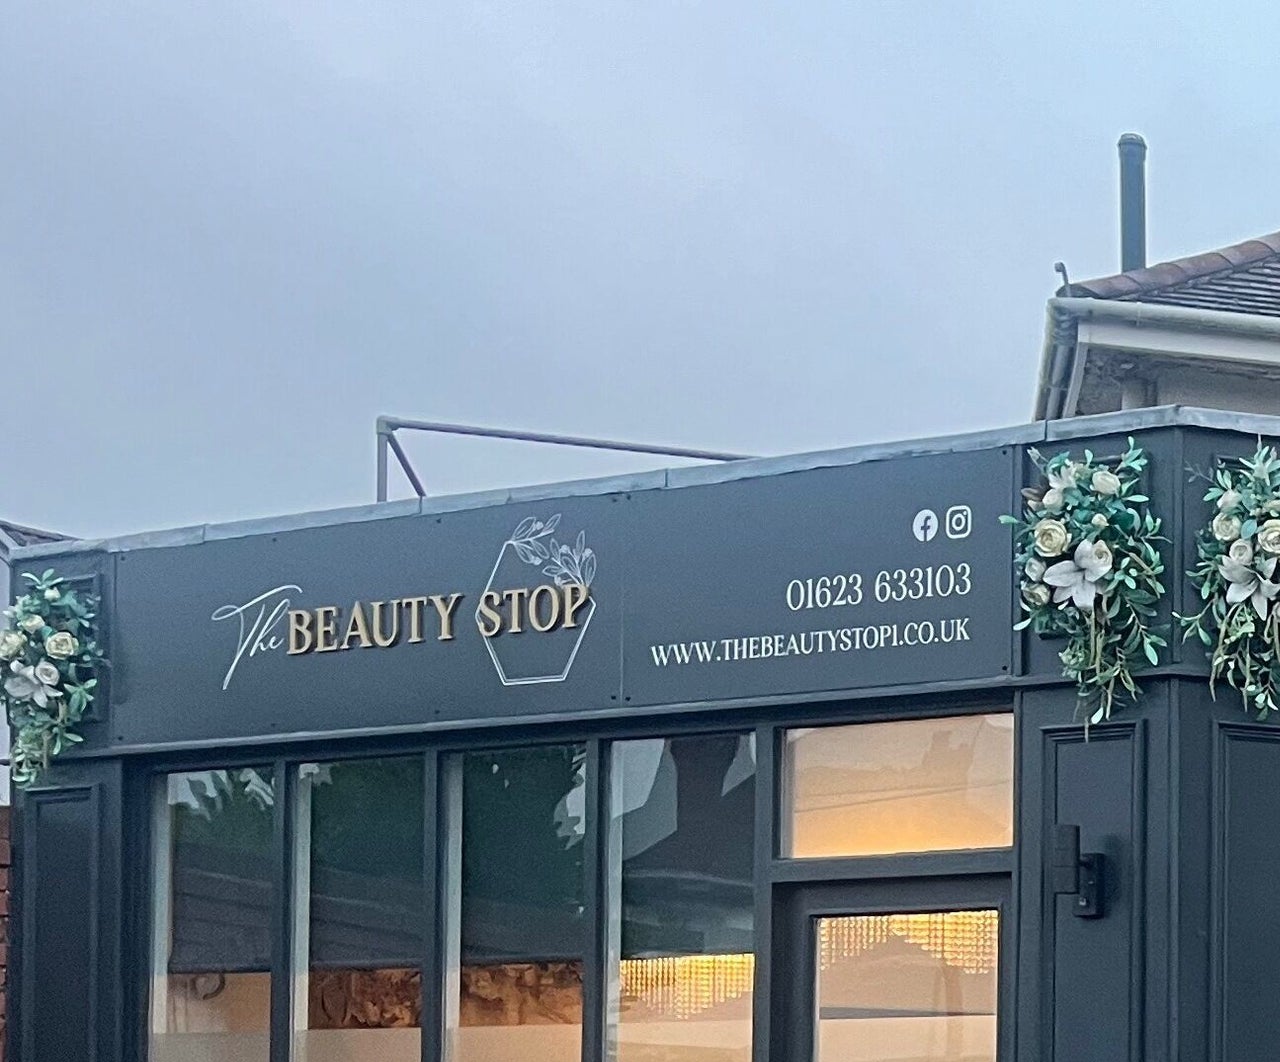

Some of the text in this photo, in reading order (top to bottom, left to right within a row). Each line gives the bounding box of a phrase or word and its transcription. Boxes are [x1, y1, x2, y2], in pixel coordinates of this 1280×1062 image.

[786, 563, 972, 611] 01623 633103
[211, 584, 591, 691] The BEAUTY STOP
